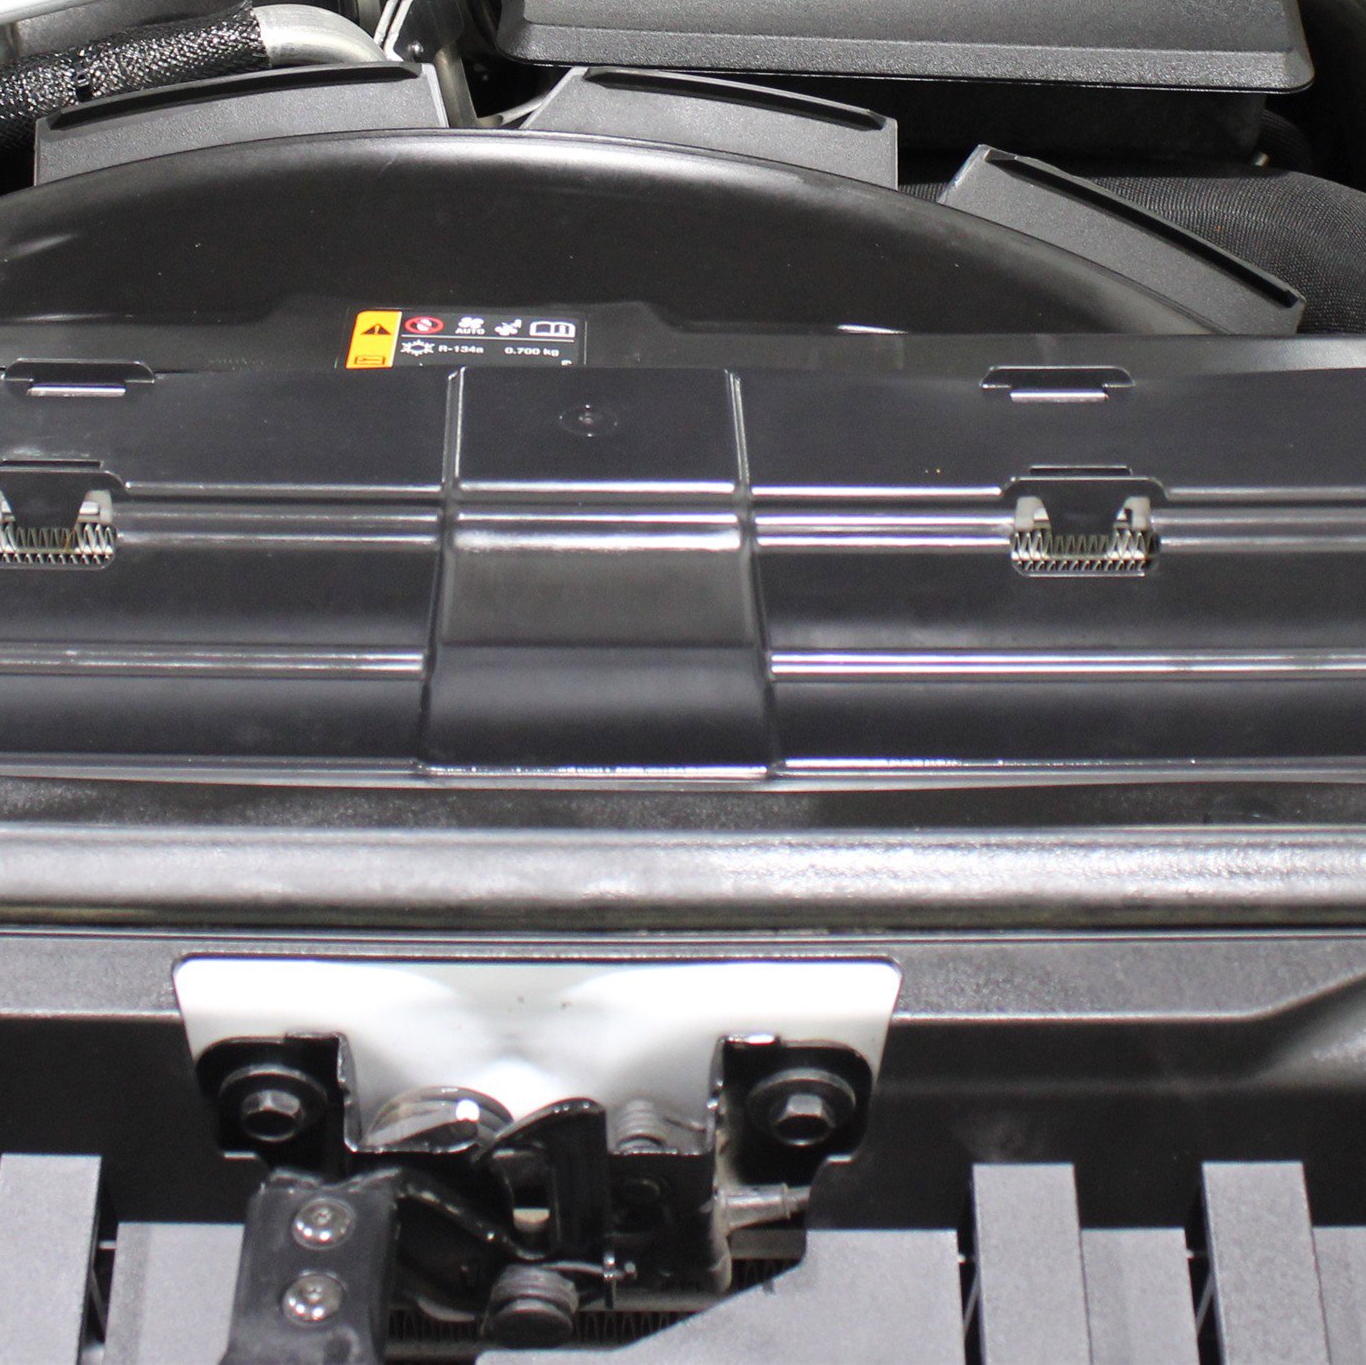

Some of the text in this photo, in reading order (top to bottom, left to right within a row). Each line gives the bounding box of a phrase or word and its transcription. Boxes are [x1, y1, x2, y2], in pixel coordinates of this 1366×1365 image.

[455, 327, 486, 335] AUTO
[438, 345, 560, 357] R-134a 0.700 kg
